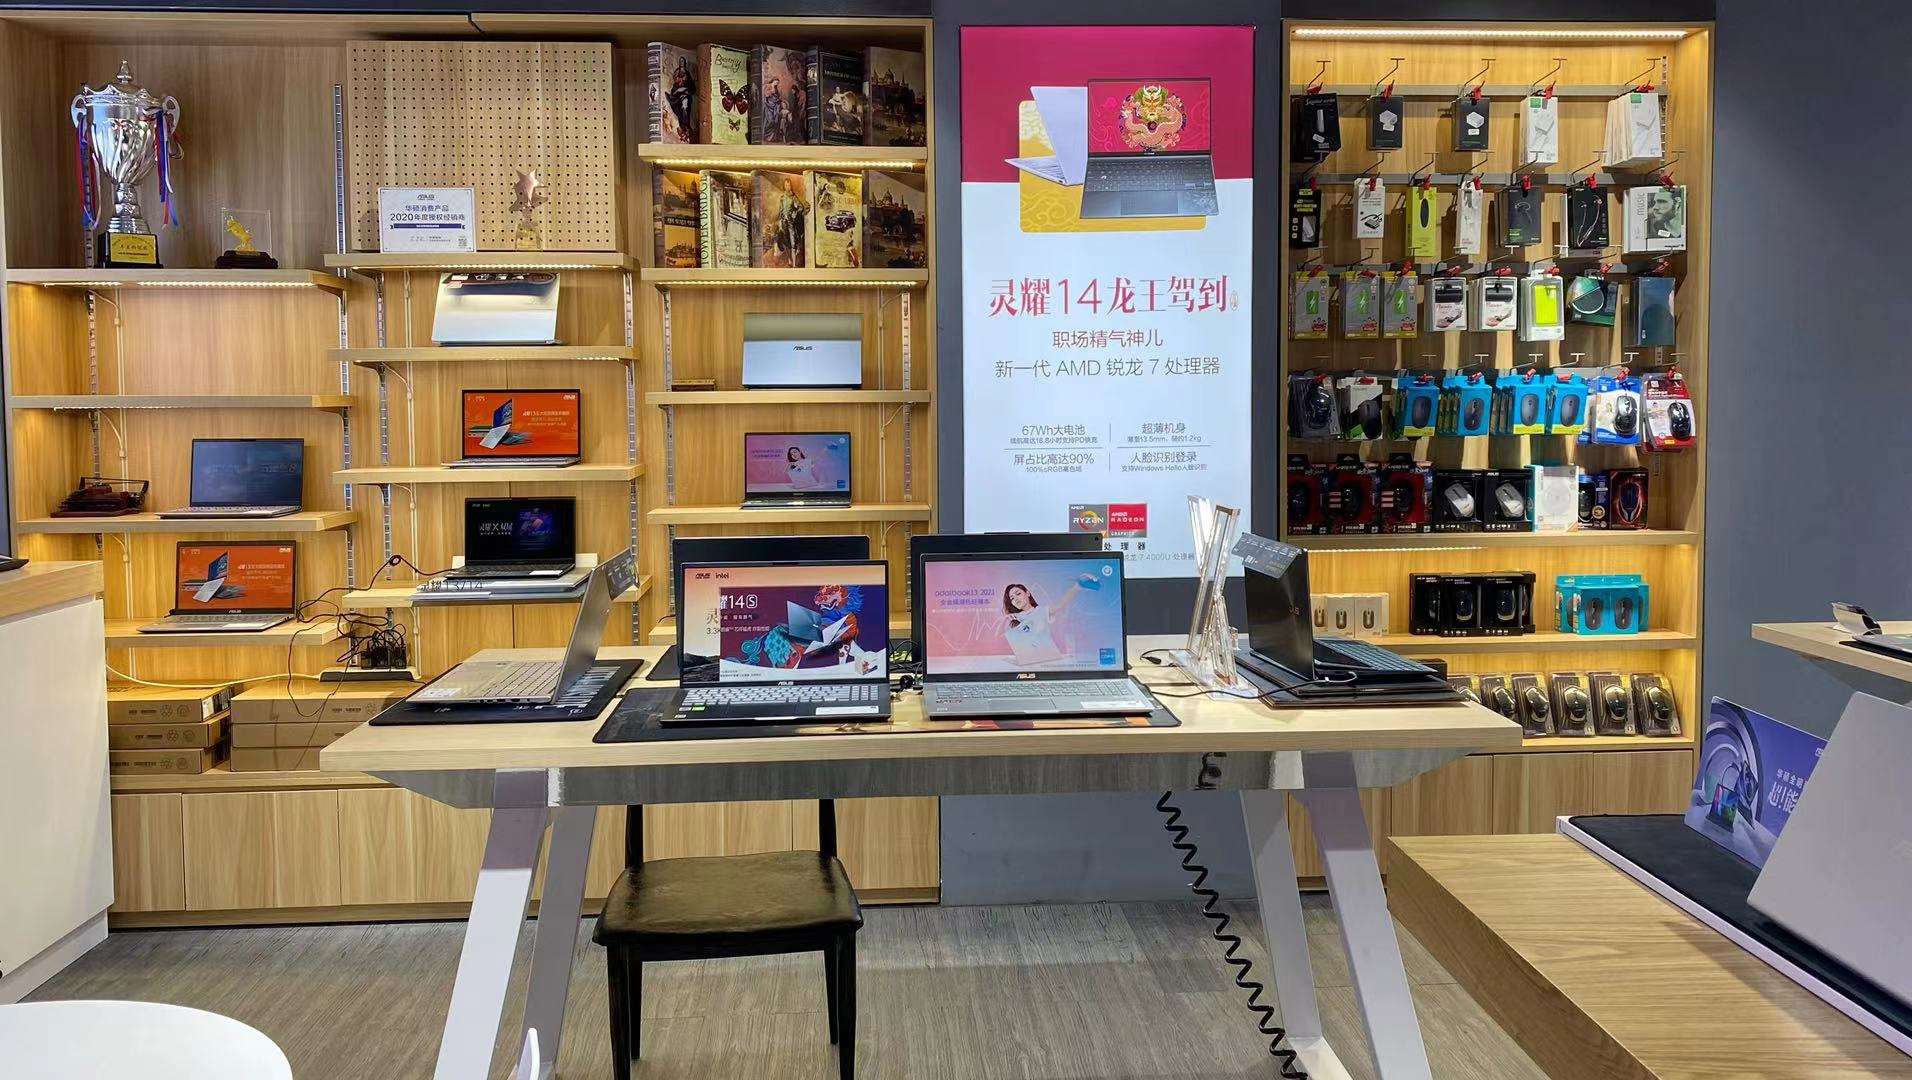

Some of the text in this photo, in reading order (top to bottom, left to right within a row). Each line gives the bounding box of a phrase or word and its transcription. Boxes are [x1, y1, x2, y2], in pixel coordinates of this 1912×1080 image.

[405, 204, 449, 212] 华硕消费产品
[390, 213, 465, 221] 2020年度授权经销商
[988, 275, 1228, 317] 灵耀14龙王驾到
[1052, 329, 1164, 348] 职场精气神儿
[995, 357, 1220, 378] 新一代 AMD 锐龙 7 处理器
[1021, 424, 1086, 436] 67Wh大电池
[1141, 422, 1186, 434] 超薄机身
[1013, 453, 1094, 465] 屏占比高达90%
[1131, 451, 1197, 463] 人脸识别登录
[1016, 672, 1036, 680] ASUS
